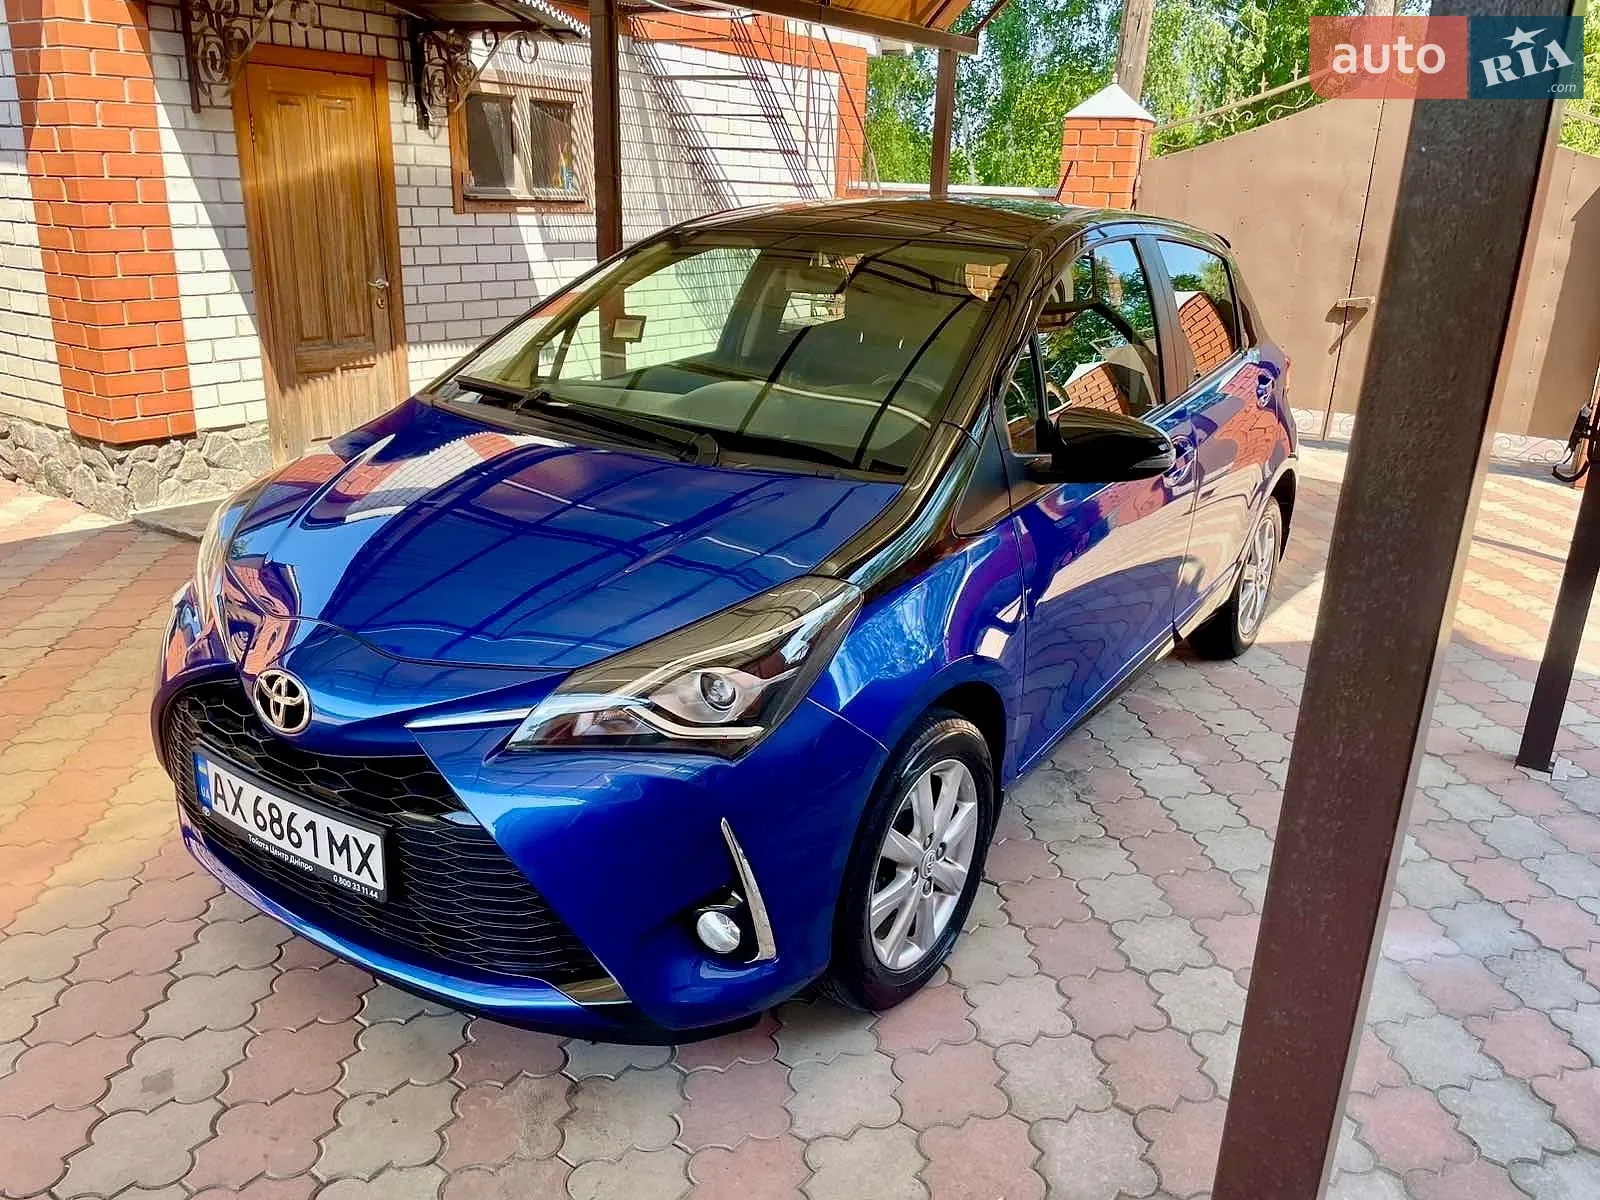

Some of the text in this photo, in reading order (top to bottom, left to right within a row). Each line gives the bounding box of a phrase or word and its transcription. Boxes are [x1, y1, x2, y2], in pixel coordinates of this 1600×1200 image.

[200, 785, 212, 799] UA
[213, 771, 378, 884] AX 6861 MX
